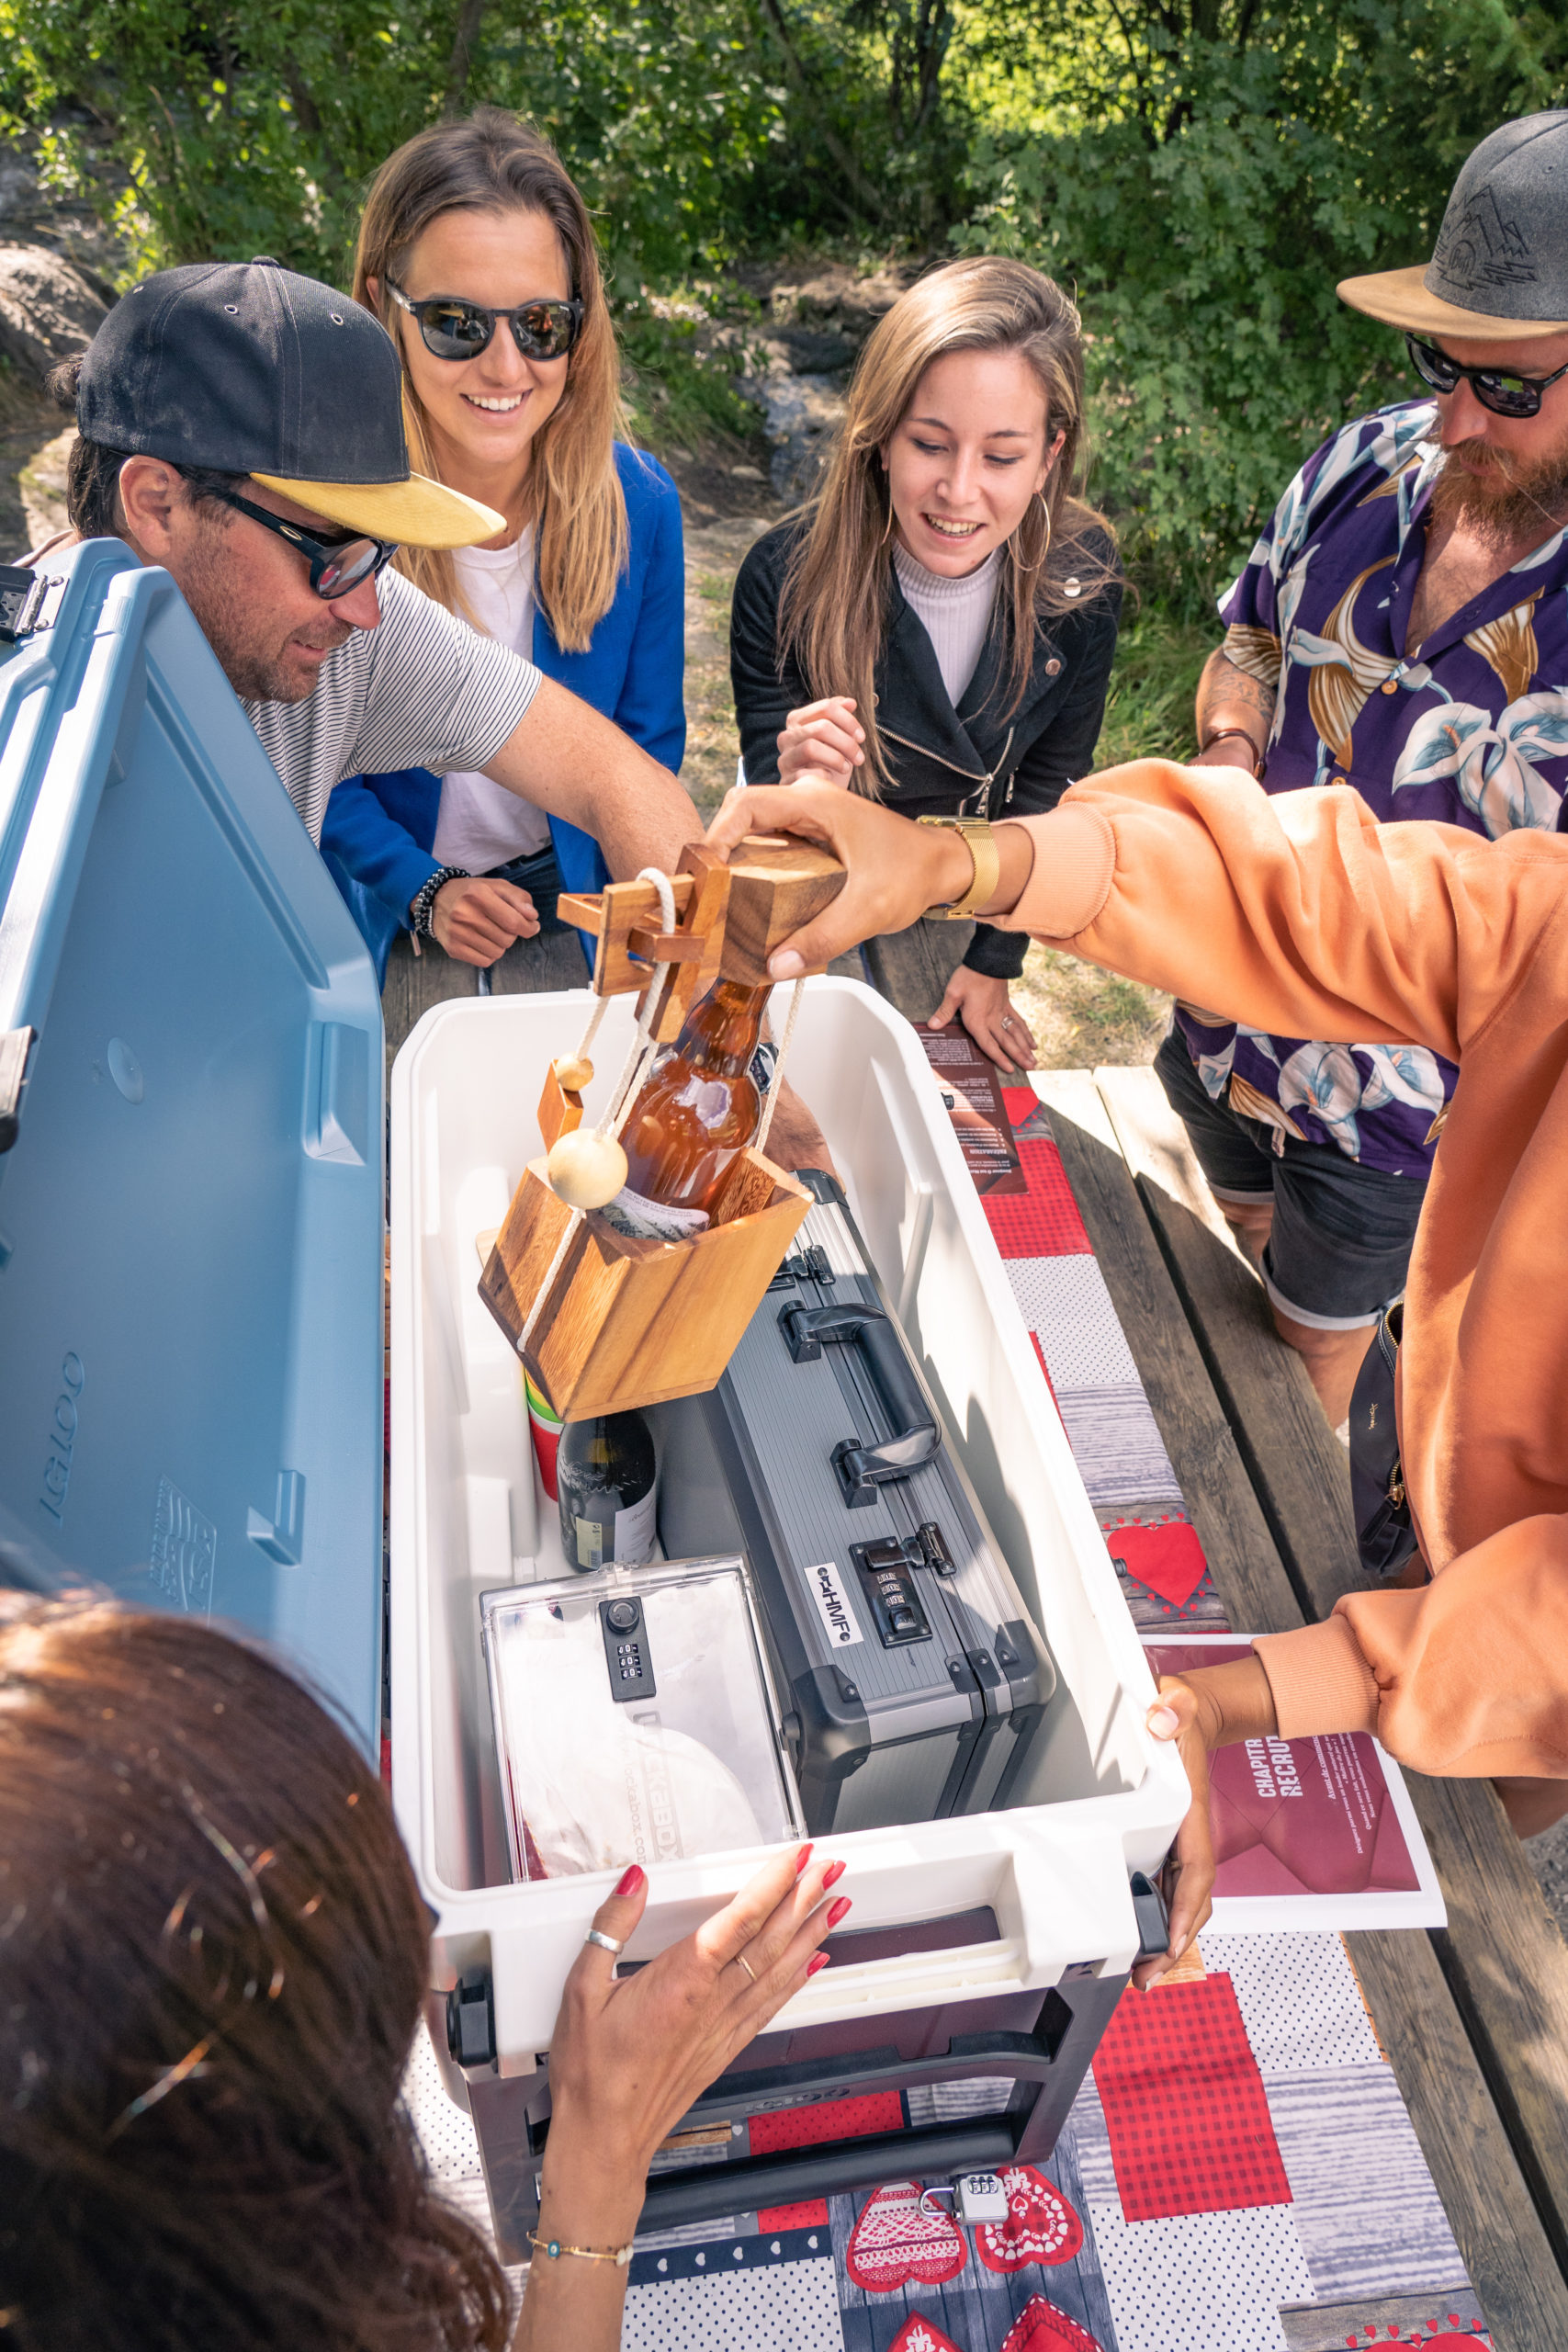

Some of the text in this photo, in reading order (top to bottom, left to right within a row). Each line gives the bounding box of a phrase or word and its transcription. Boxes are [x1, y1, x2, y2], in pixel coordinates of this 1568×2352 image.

[39, 1351, 85, 1529] IGLOO
[822, 1591, 851, 1633] HMF
[1244, 1737, 1278, 1798] CHAPITR
[1321, 1769, 1330, 1778] de
[1325, 1779, 1336, 1799] Avant
[1363, 1790, 1371, 1803] vous
[1342, 1796, 1350, 1810] vous
[1346, 1811, 1356, 1827] parmi
[1359, 1812, 1371, 1830] Quand
[744, 2087, 851, 2113] IGLOO
